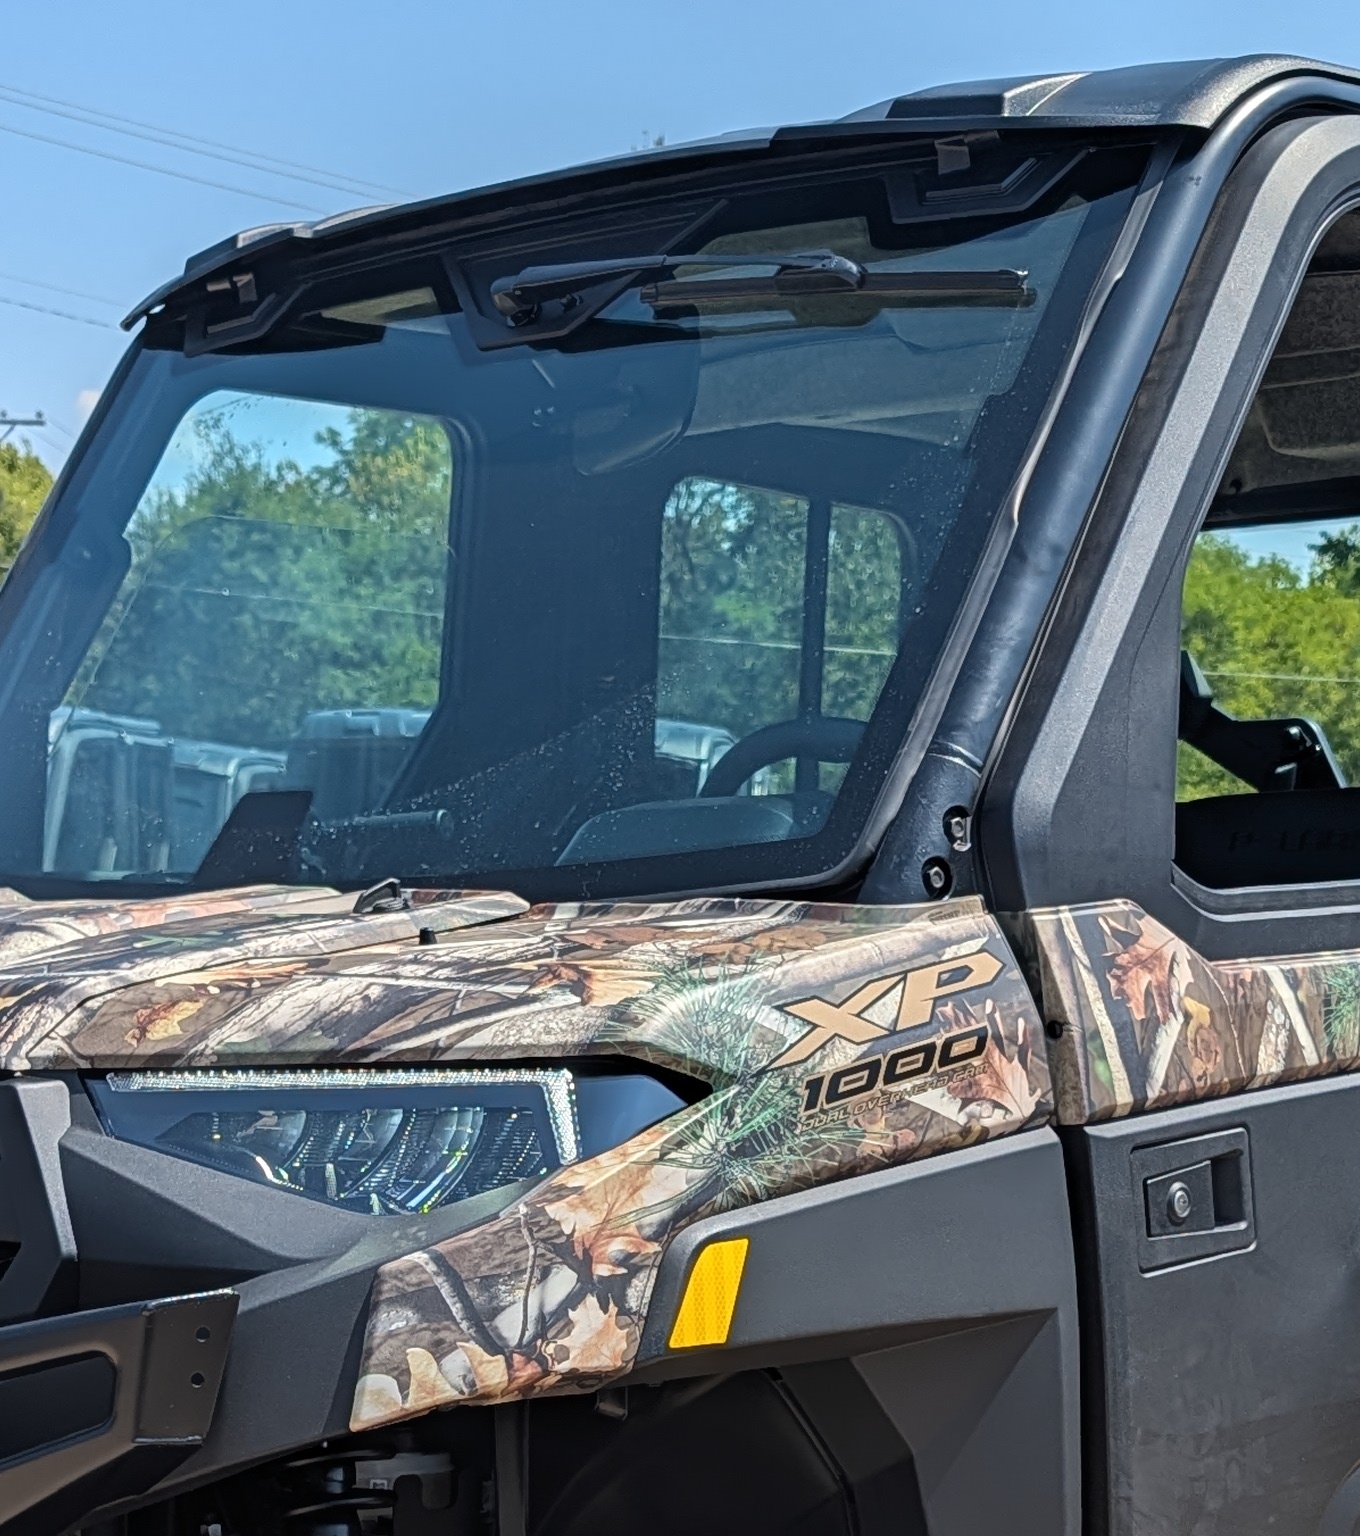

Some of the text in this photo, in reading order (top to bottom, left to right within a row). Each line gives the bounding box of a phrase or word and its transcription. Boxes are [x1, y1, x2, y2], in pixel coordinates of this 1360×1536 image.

[752, 950, 1006, 1076] XP
[798, 1062, 990, 1132] DUAL OVERHEAD CAM
[800, 1023, 989, 1115] 1000
